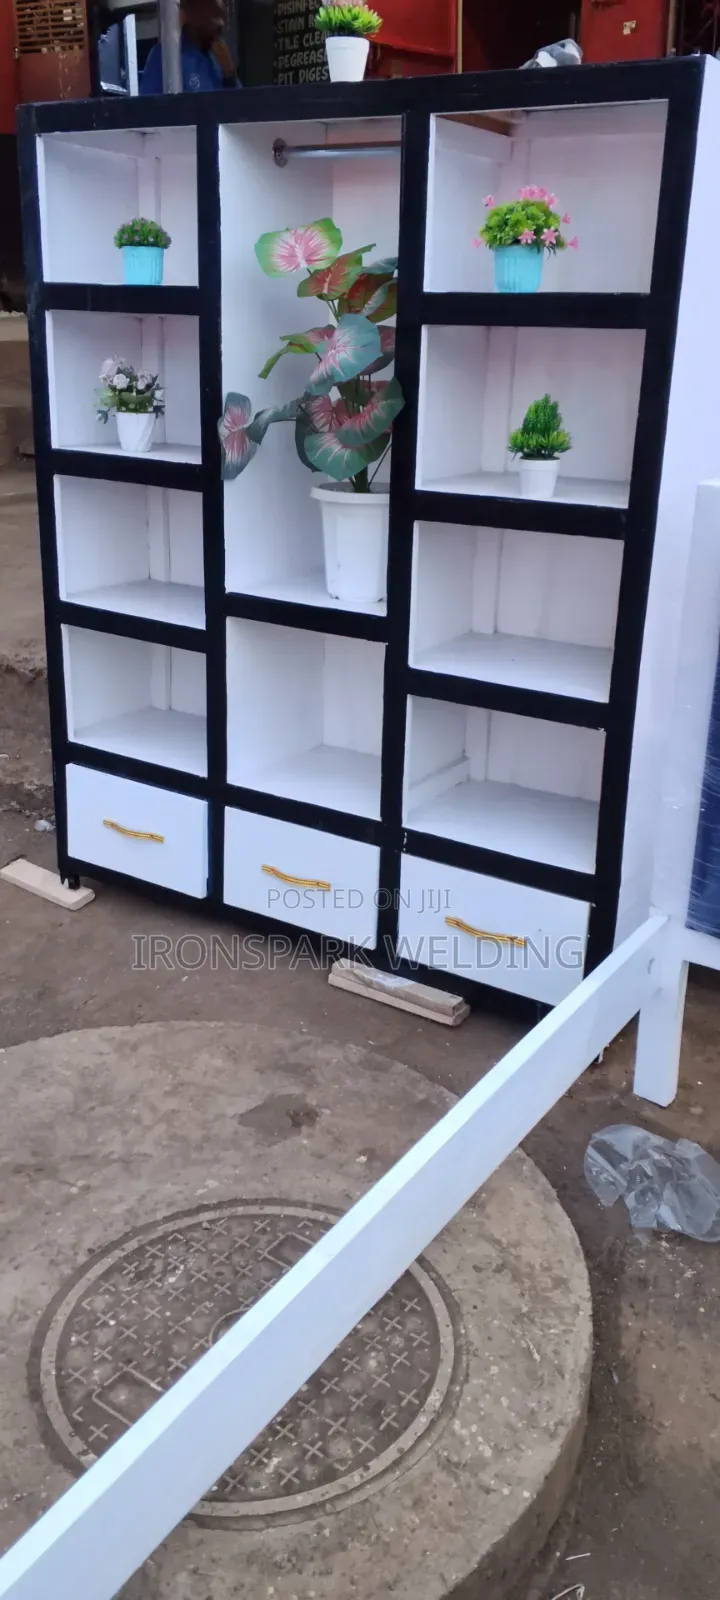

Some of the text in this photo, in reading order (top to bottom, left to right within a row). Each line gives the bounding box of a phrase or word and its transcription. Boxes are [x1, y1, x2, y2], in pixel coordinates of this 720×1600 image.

[277, 0, 320, 16] DISINFEC
[277, 30, 327, 51] TILE CLEA
[299, 66, 329, 84] DIGES
